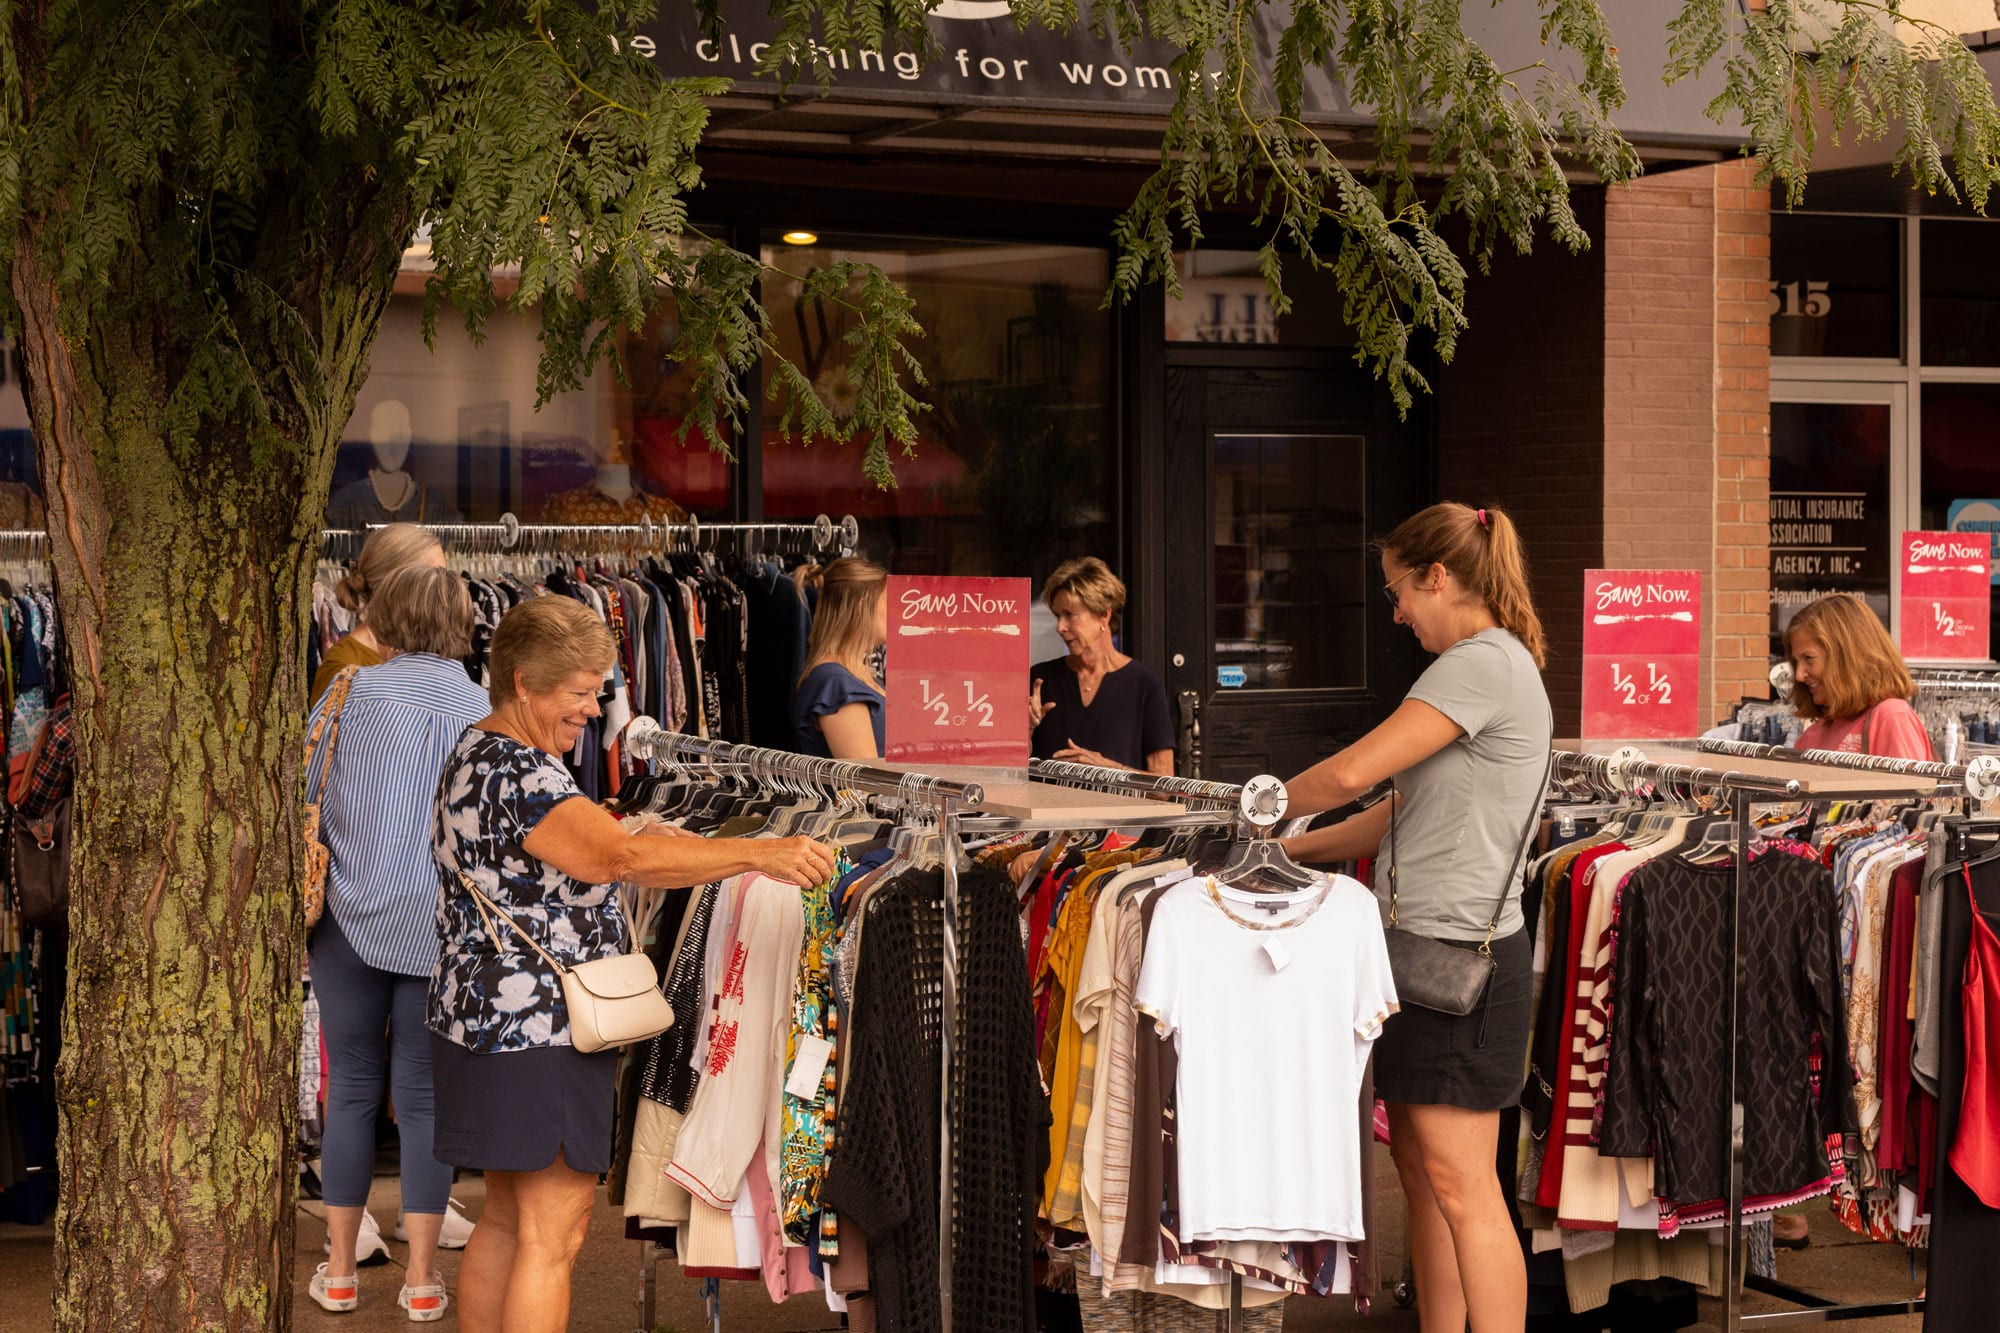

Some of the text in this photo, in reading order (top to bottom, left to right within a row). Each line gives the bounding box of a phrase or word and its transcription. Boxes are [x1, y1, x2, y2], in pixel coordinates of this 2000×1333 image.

[696, 33, 920, 80] clohing
[955, 49, 1028, 81] for
[1770, 499, 1865, 520] UTUAL INSURANCE
[1769, 523, 1832, 544] SSOCIATION
[1909, 540, 1946, 562] Save
[1948, 543, 1983, 559] Now.
[1774, 556, 1825, 575] AGENCY,
[900, 589, 1018, 620] Save Now.
[1595, 582, 1691, 610] Save Now.
[1638, 694, 1651, 705] OF
[952, 715, 968, 727] OF
[1248, 783, 1259, 793] M
[1270, 783, 1280, 793] M
